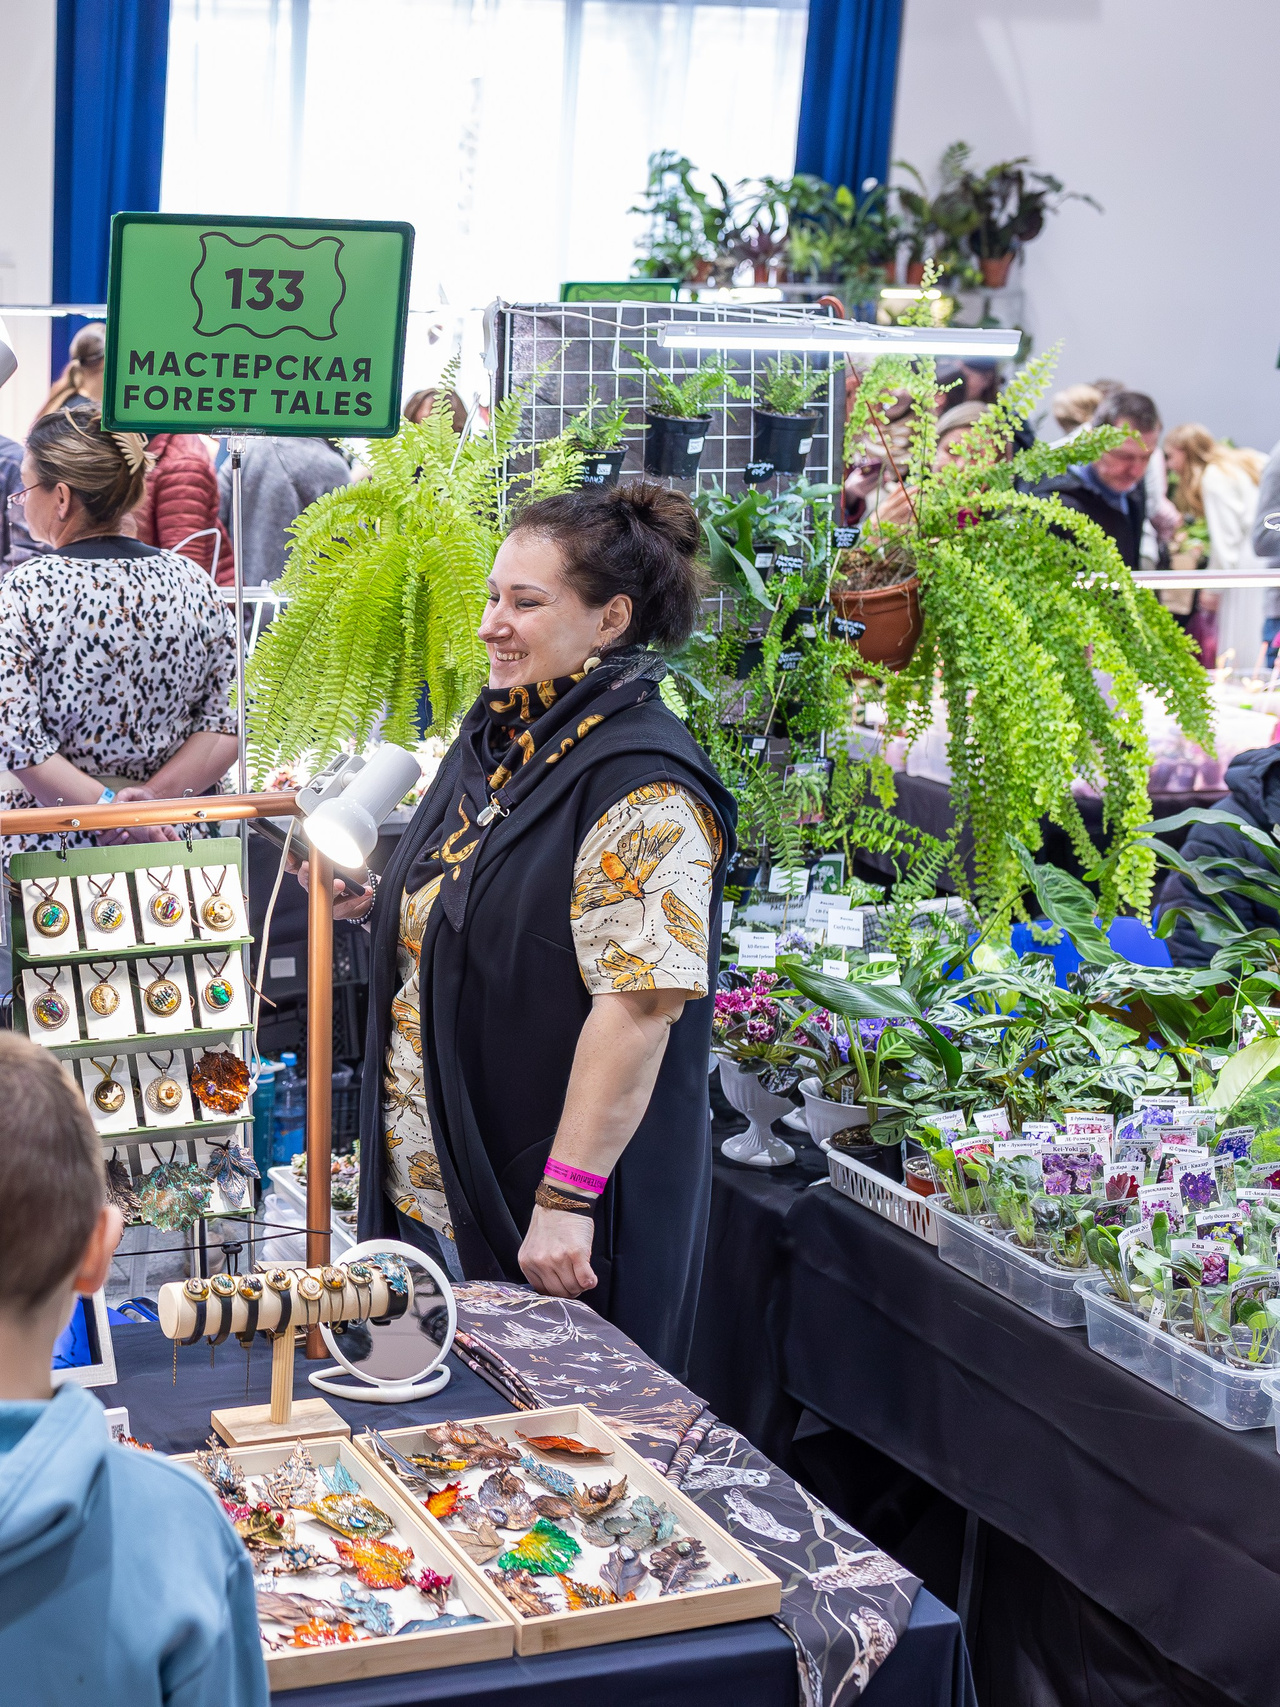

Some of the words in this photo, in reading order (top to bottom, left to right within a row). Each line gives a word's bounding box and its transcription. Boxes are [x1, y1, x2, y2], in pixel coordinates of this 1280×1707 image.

[225, 267, 305, 312] 133
[129, 350, 372, 382] МАСТЕРСКАЯ
[123, 385, 257, 413] FOREST
[270, 389, 373, 416] TALES
[1191, 1161, 1209, 1170] Квазар
